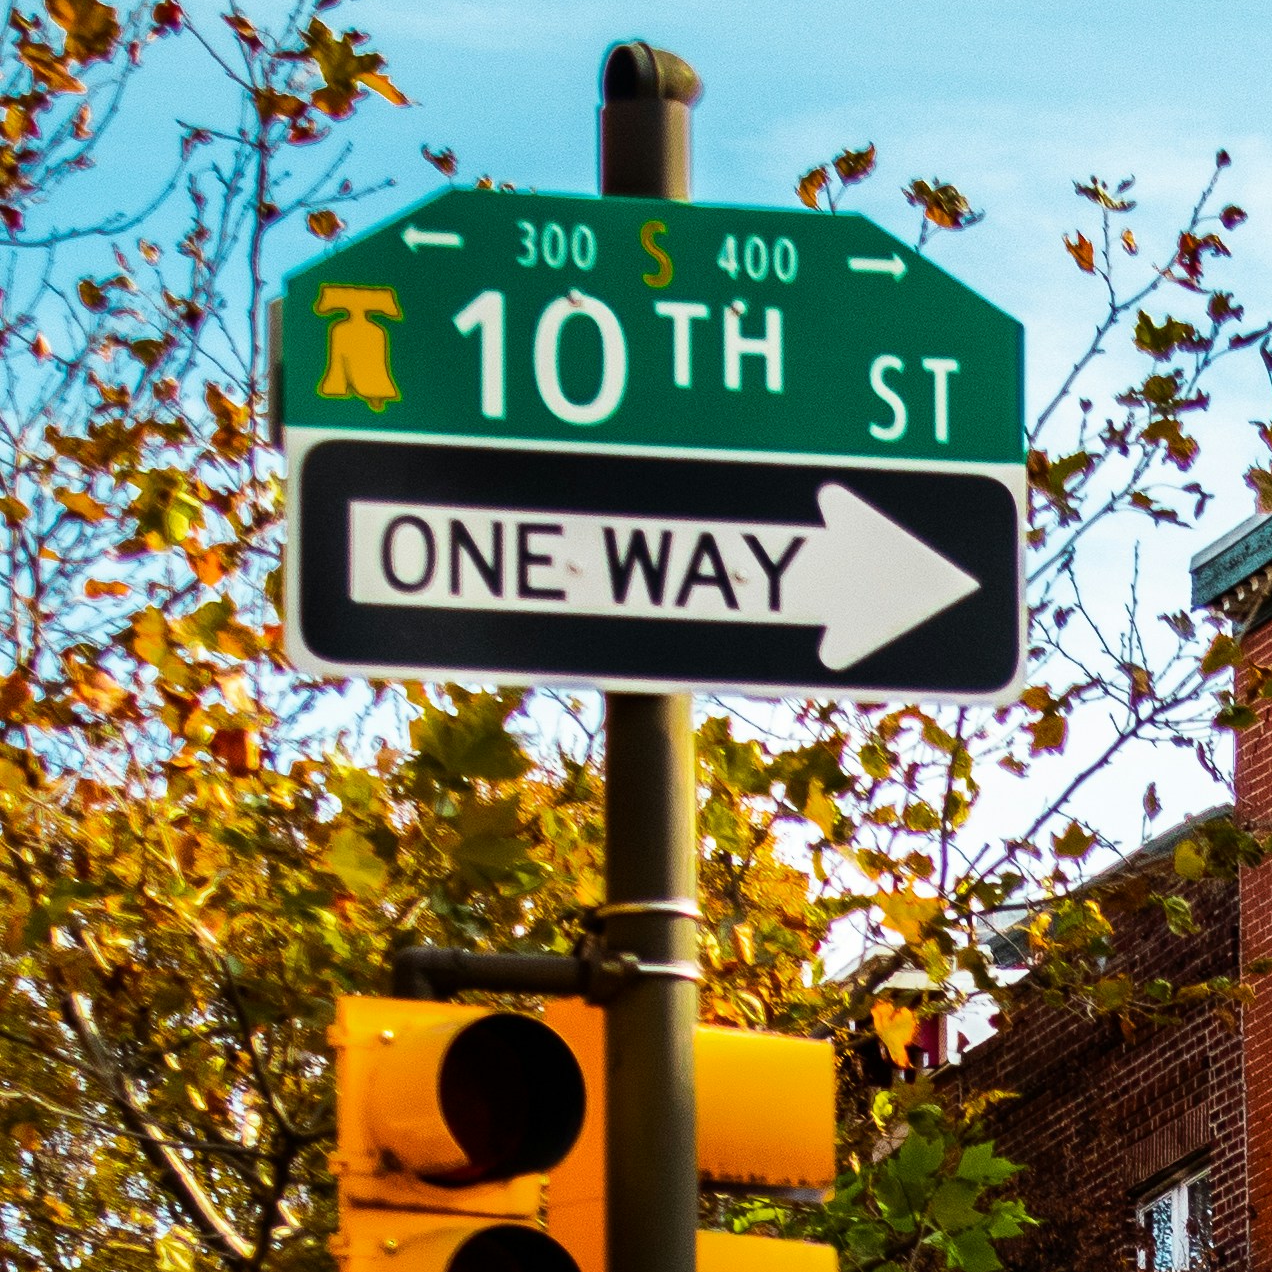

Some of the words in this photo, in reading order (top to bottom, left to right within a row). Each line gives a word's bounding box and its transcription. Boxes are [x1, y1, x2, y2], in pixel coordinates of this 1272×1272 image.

[516, 221, 597, 271] 300
[640, 220, 674, 287] S
[717, 234, 798, 283] 400
[452, 289, 784, 426] 10TH
[868, 354, 959, 444] ST
[380, 514, 568, 602] ONE
[602, 525, 809, 613] WAY
